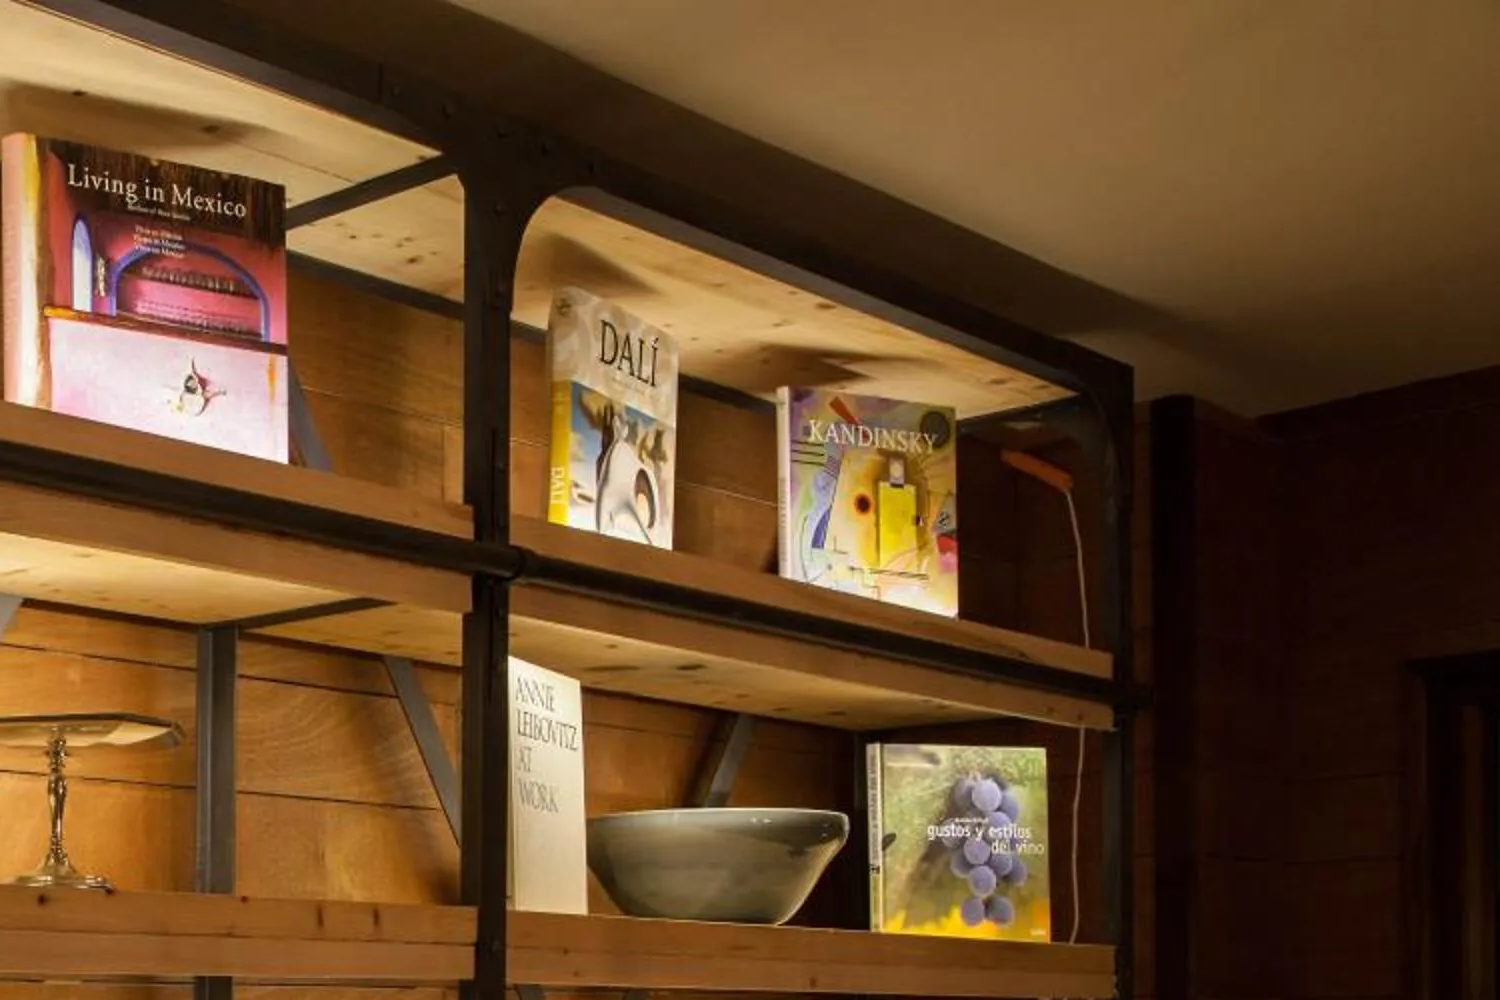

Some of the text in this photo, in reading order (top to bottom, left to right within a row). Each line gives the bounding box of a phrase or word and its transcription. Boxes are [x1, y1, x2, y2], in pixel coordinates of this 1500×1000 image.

[67, 163, 138, 203] Living
[145, 178, 165, 203] in
[171, 183, 247, 218] Mexico
[600, 319, 660, 388] DALÍ
[808, 418, 938, 453] KANDINSKY
[516, 677, 555, 712] ANNIE
[518, 746, 533, 773] AT
[518, 778, 560, 813] WORK
[927, 823, 1032, 841] gustos y estilos
[991, 839, 1045, 855] del vino
